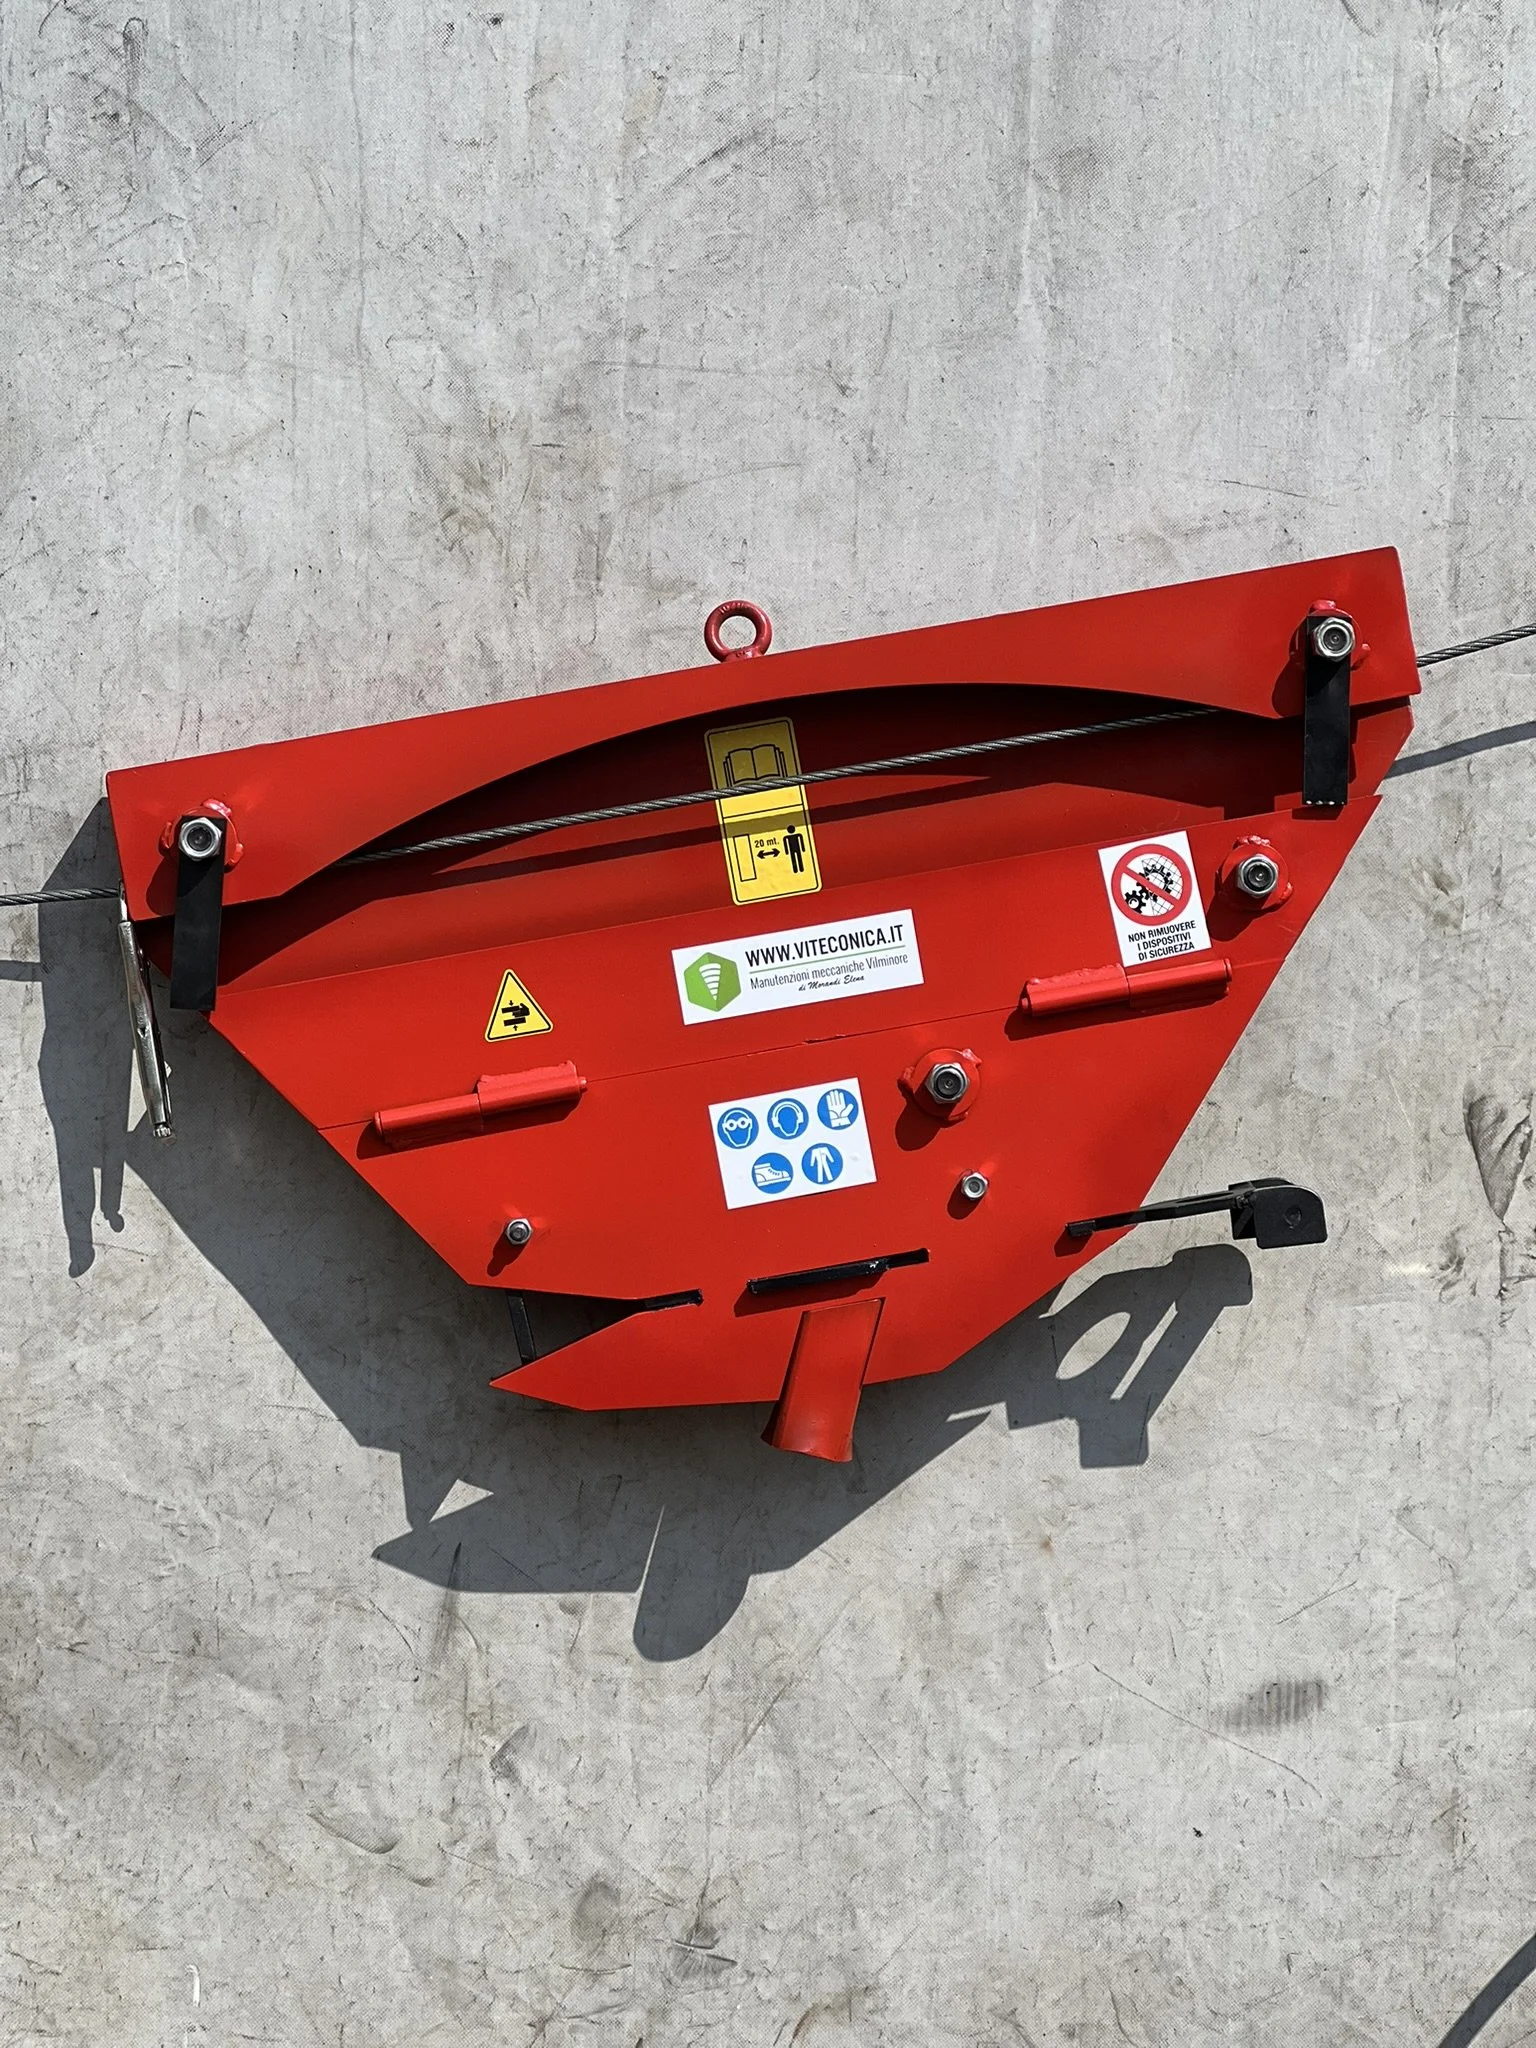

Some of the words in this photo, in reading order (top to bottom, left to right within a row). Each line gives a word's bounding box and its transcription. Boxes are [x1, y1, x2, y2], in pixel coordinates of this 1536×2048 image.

[754, 839, 765, 848] 20
[766, 837, 780, 846] mt.
[1128, 931, 1146, 943] NON
[1148, 920, 1197, 938] RIMUOVERE
[1143, 931, 1191, 950] DISPOSITIVI
[745, 924, 904, 967] WWW.VITECONICA.IT
[1138, 952, 1148, 961] DI
[1149, 941, 1195, 959] SICUREZZA
[750, 968, 811, 990] Manutenzioni
[811, 960, 864, 979] meccaniche
[865, 953, 909, 970] Vilminore
[798, 984, 806, 992] di
[808, 978, 841, 989] Morandi
[843, 974, 865, 984] Elena
